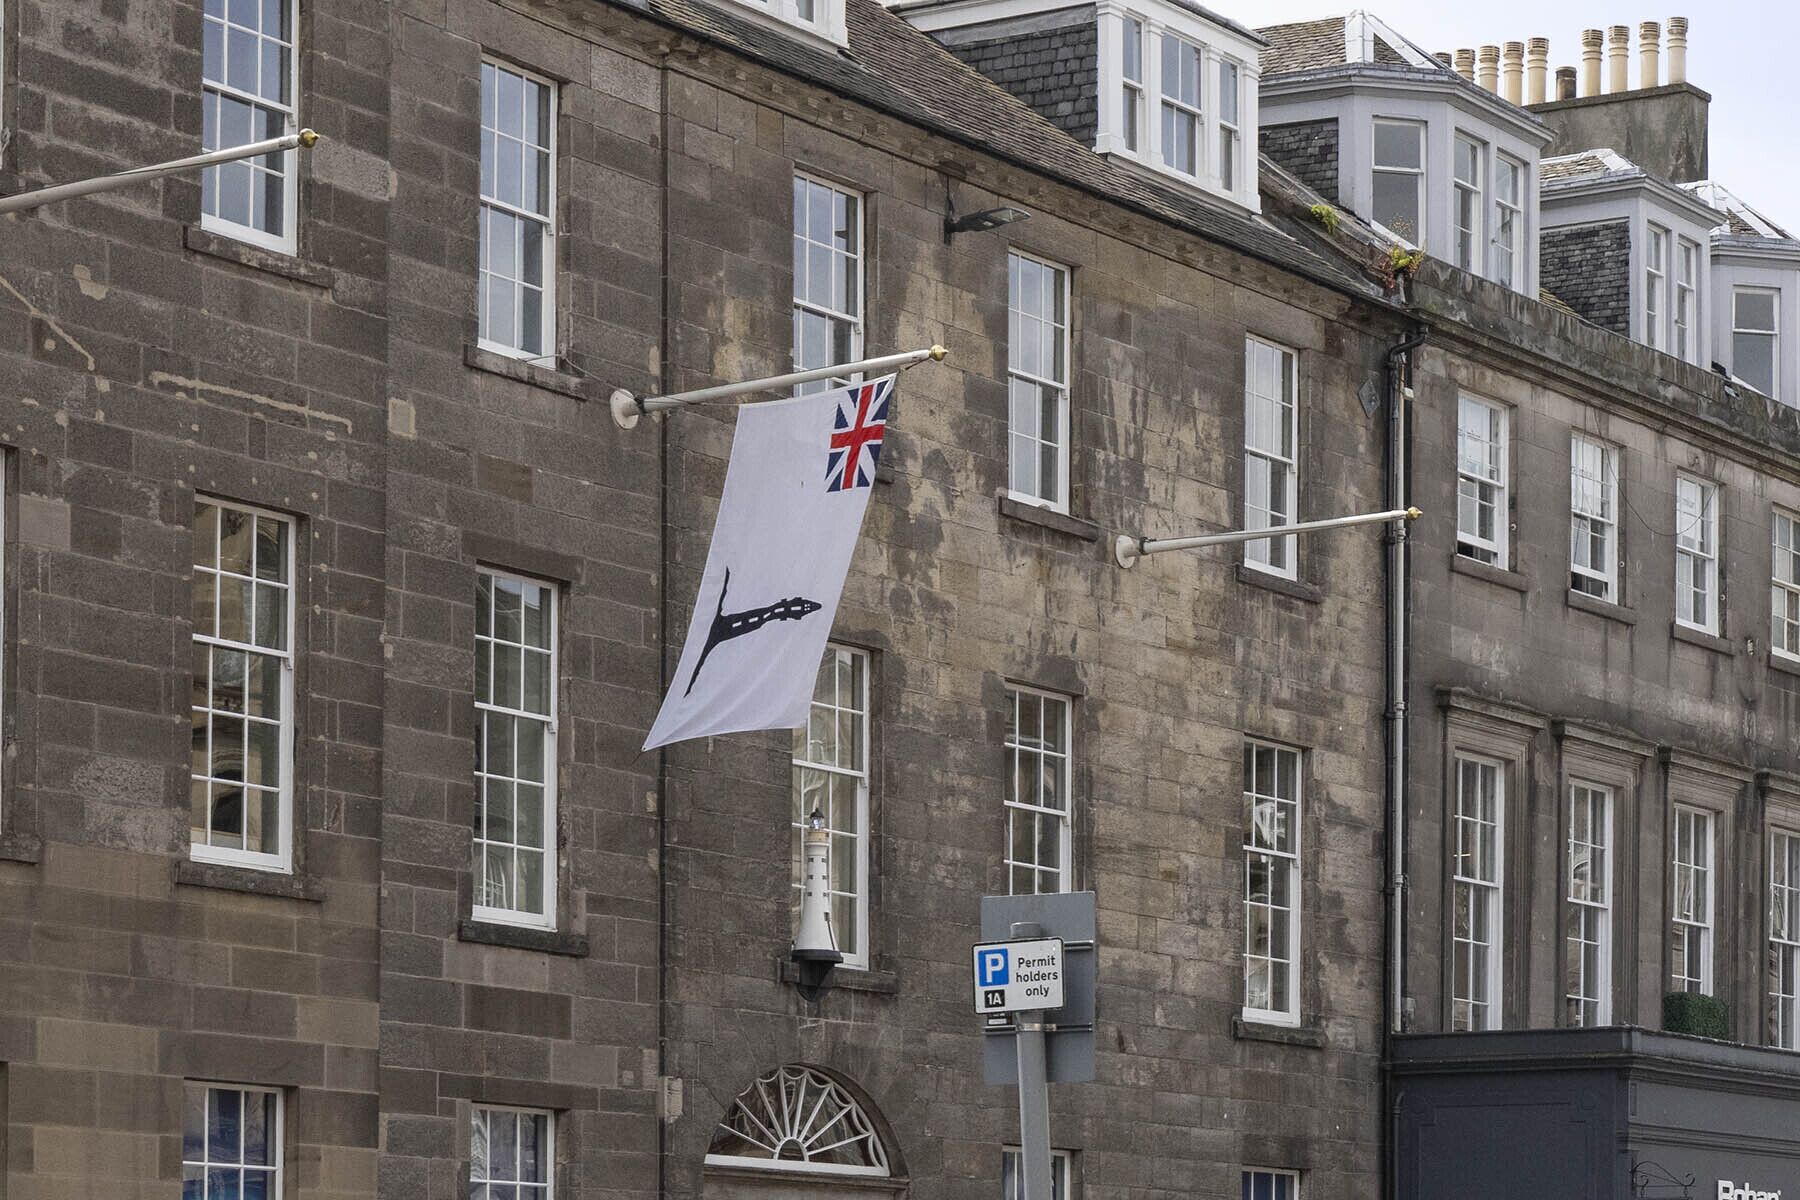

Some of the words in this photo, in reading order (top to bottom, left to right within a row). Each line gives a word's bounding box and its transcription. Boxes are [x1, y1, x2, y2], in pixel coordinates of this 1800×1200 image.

[985, 953, 1004, 983] P
[1018, 955, 1056, 968] Permit
[1016, 971, 1058, 982] holders
[1025, 984, 1049, 997] only
[987, 993, 1002, 1005] 1A
